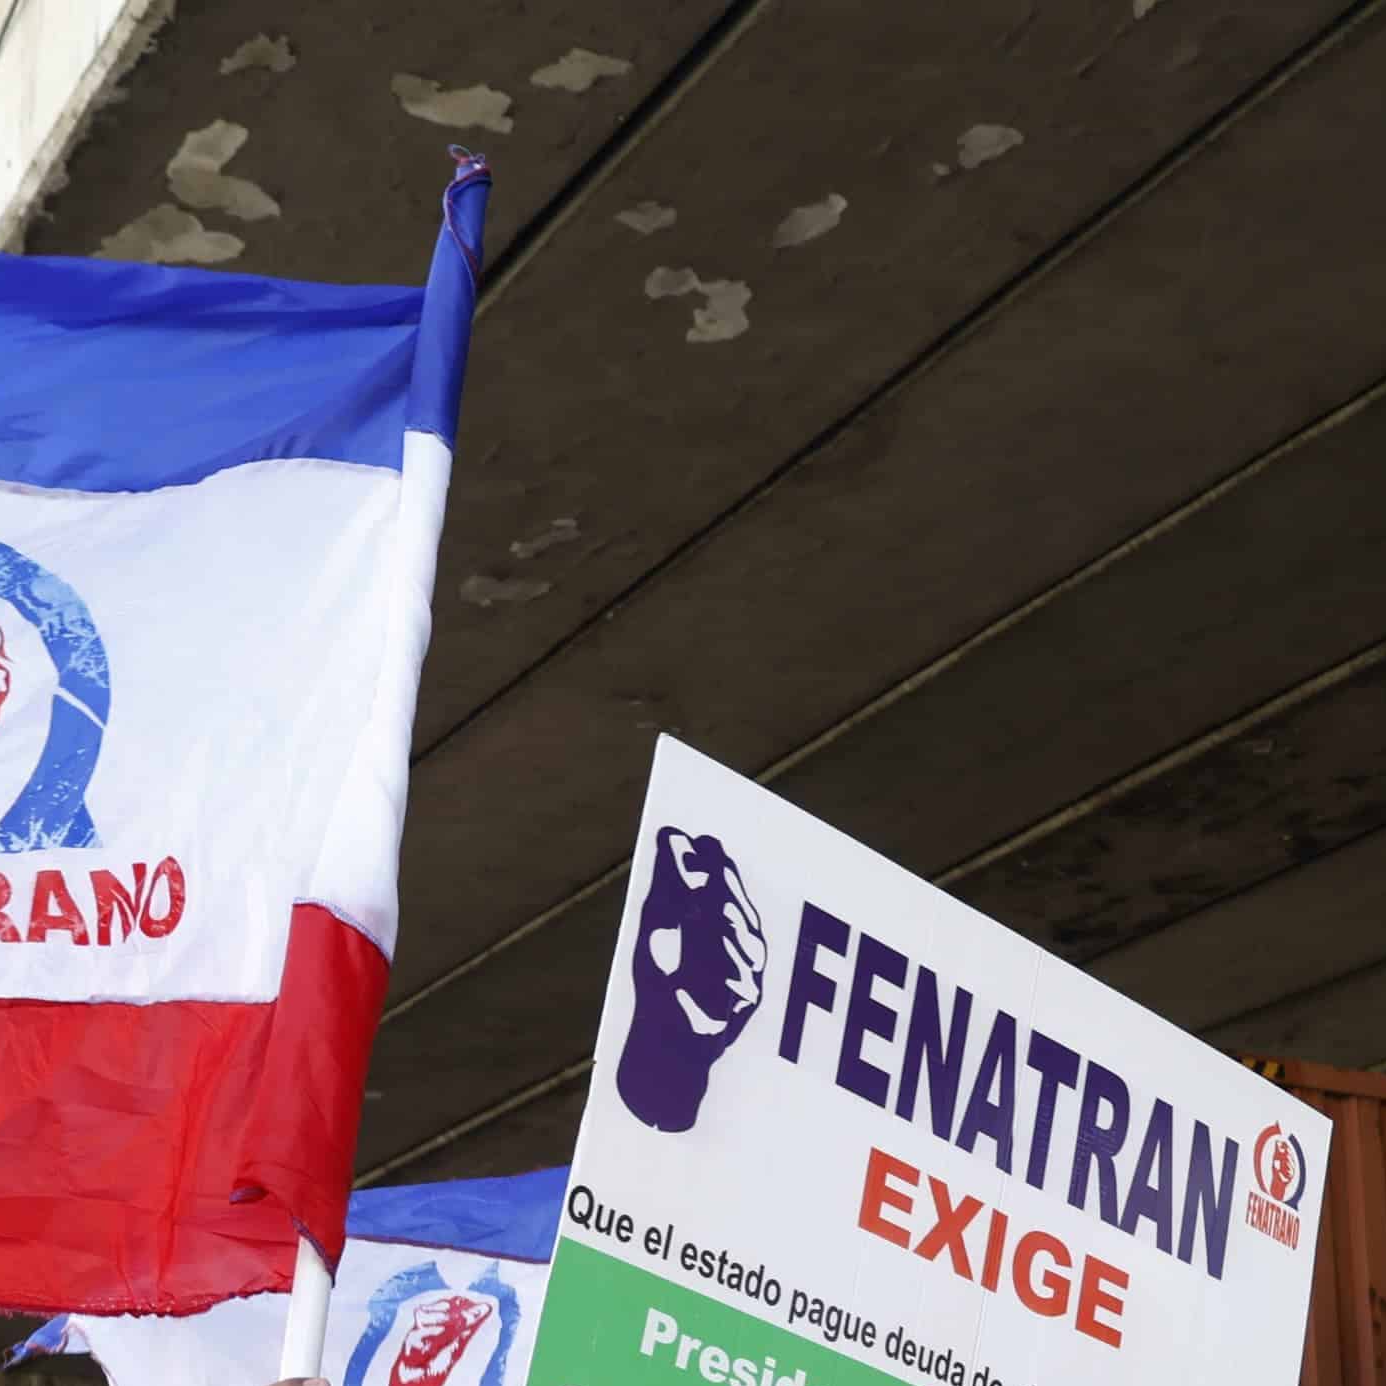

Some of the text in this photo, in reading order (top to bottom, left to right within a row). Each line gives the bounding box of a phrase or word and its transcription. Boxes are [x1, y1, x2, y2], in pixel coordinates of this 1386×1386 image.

[779, 900, 1239, 1281] FENATRAN
[567, 1185, 633, 1243] Que
[644, 1224, 674, 1260] el
[680, 1241, 781, 1307] estado
[789, 1289, 876, 1348] pague
[858, 1147, 1130, 1349] EXIGE
